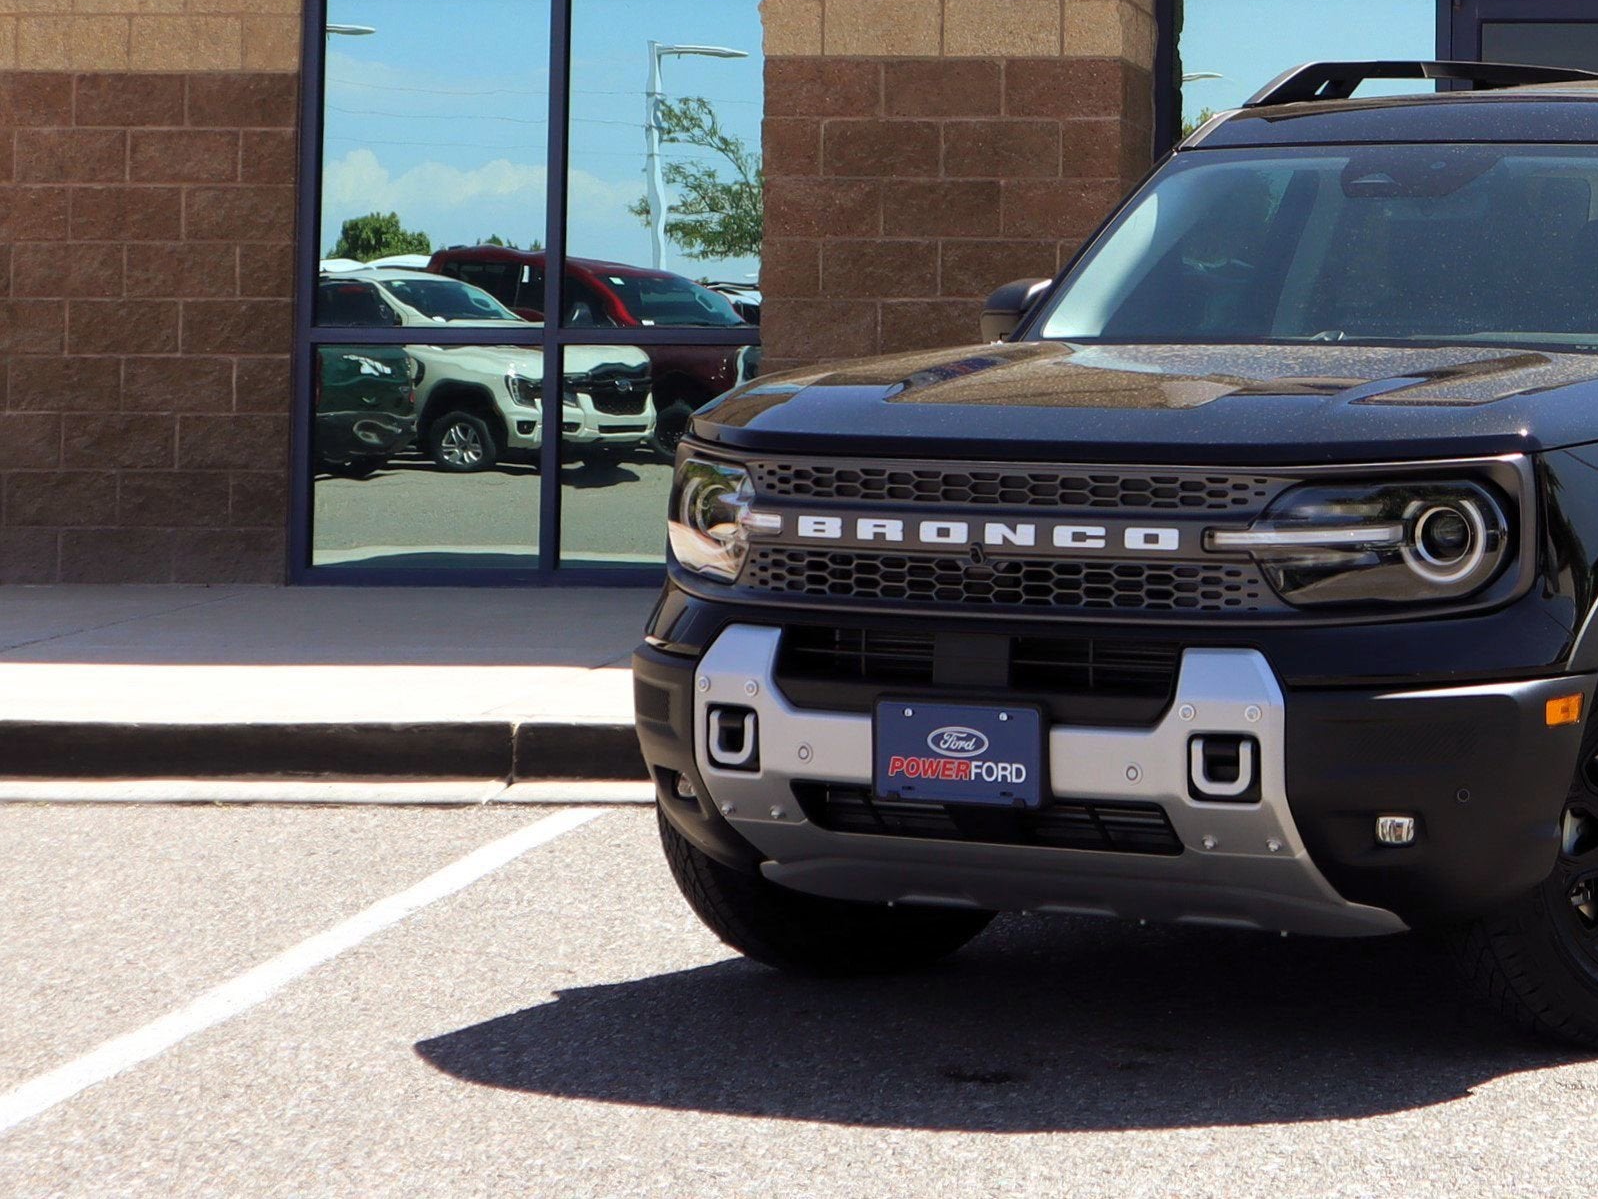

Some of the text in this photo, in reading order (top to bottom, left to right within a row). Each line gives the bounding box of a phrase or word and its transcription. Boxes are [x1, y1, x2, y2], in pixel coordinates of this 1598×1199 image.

[797, 514, 1180, 551] BRONCO
[939, 731, 976, 751] Ford
[888, 756, 1027, 784] POWERFORD
